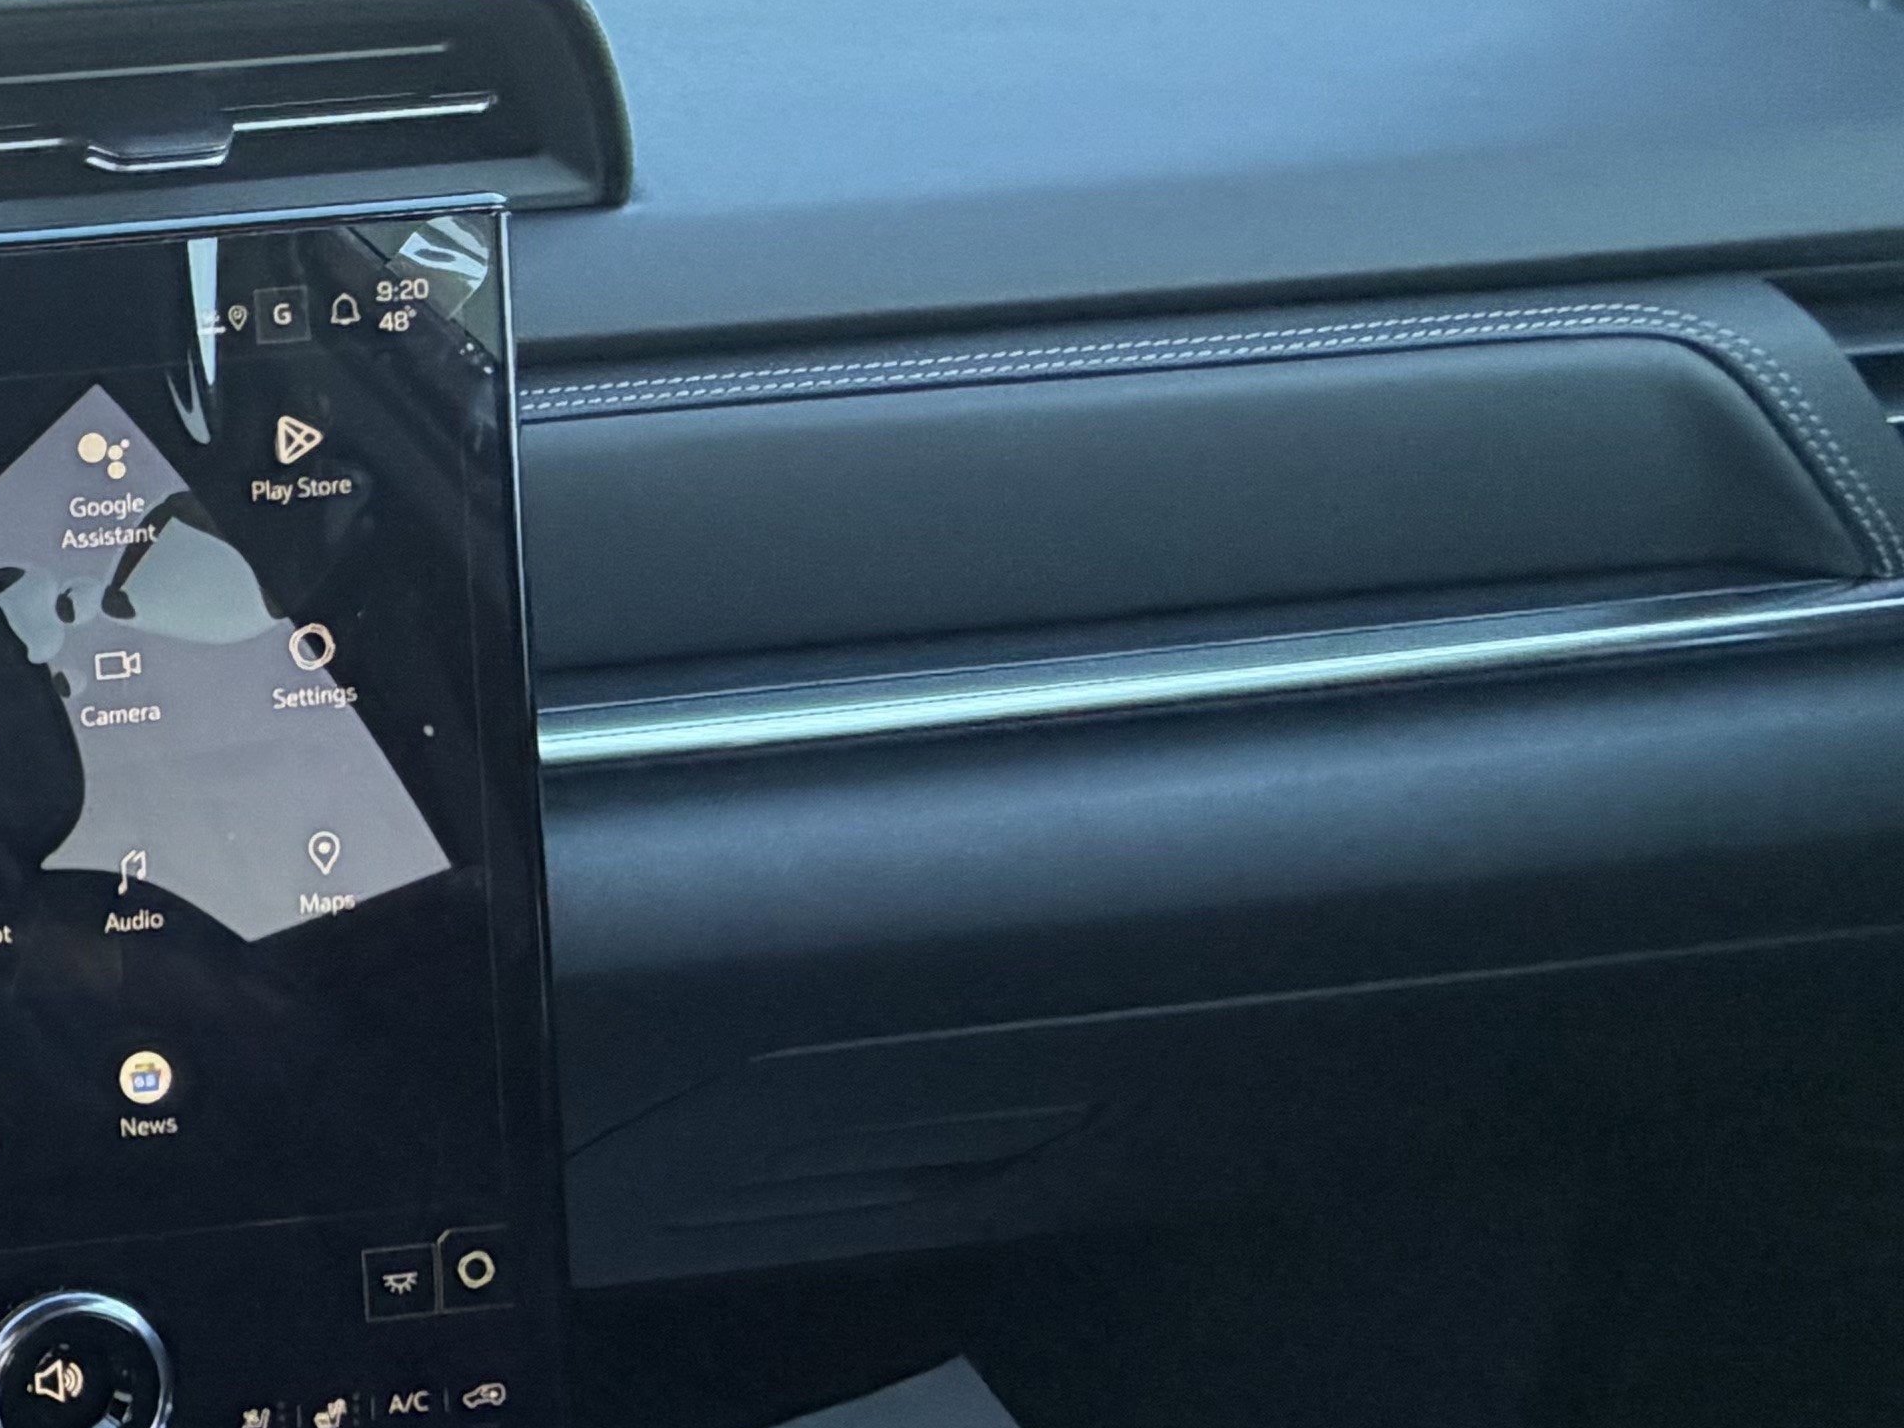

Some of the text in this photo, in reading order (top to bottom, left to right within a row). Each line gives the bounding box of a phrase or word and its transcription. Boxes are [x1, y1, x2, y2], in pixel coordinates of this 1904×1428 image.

[376, 278, 429, 302] 9:20
[273, 303, 293, 325] G
[251, 476, 353, 506] Play Store
[69, 493, 145, 521] Google
[61, 523, 158, 550] Assistant
[272, 684, 358, 710] Settings
[80, 705, 162, 728] Camera
[299, 892, 357, 917] Maps
[104, 909, 165, 934] Audio
[120, 1115, 179, 1138] News
[389, 1390, 431, 1414] A/C
